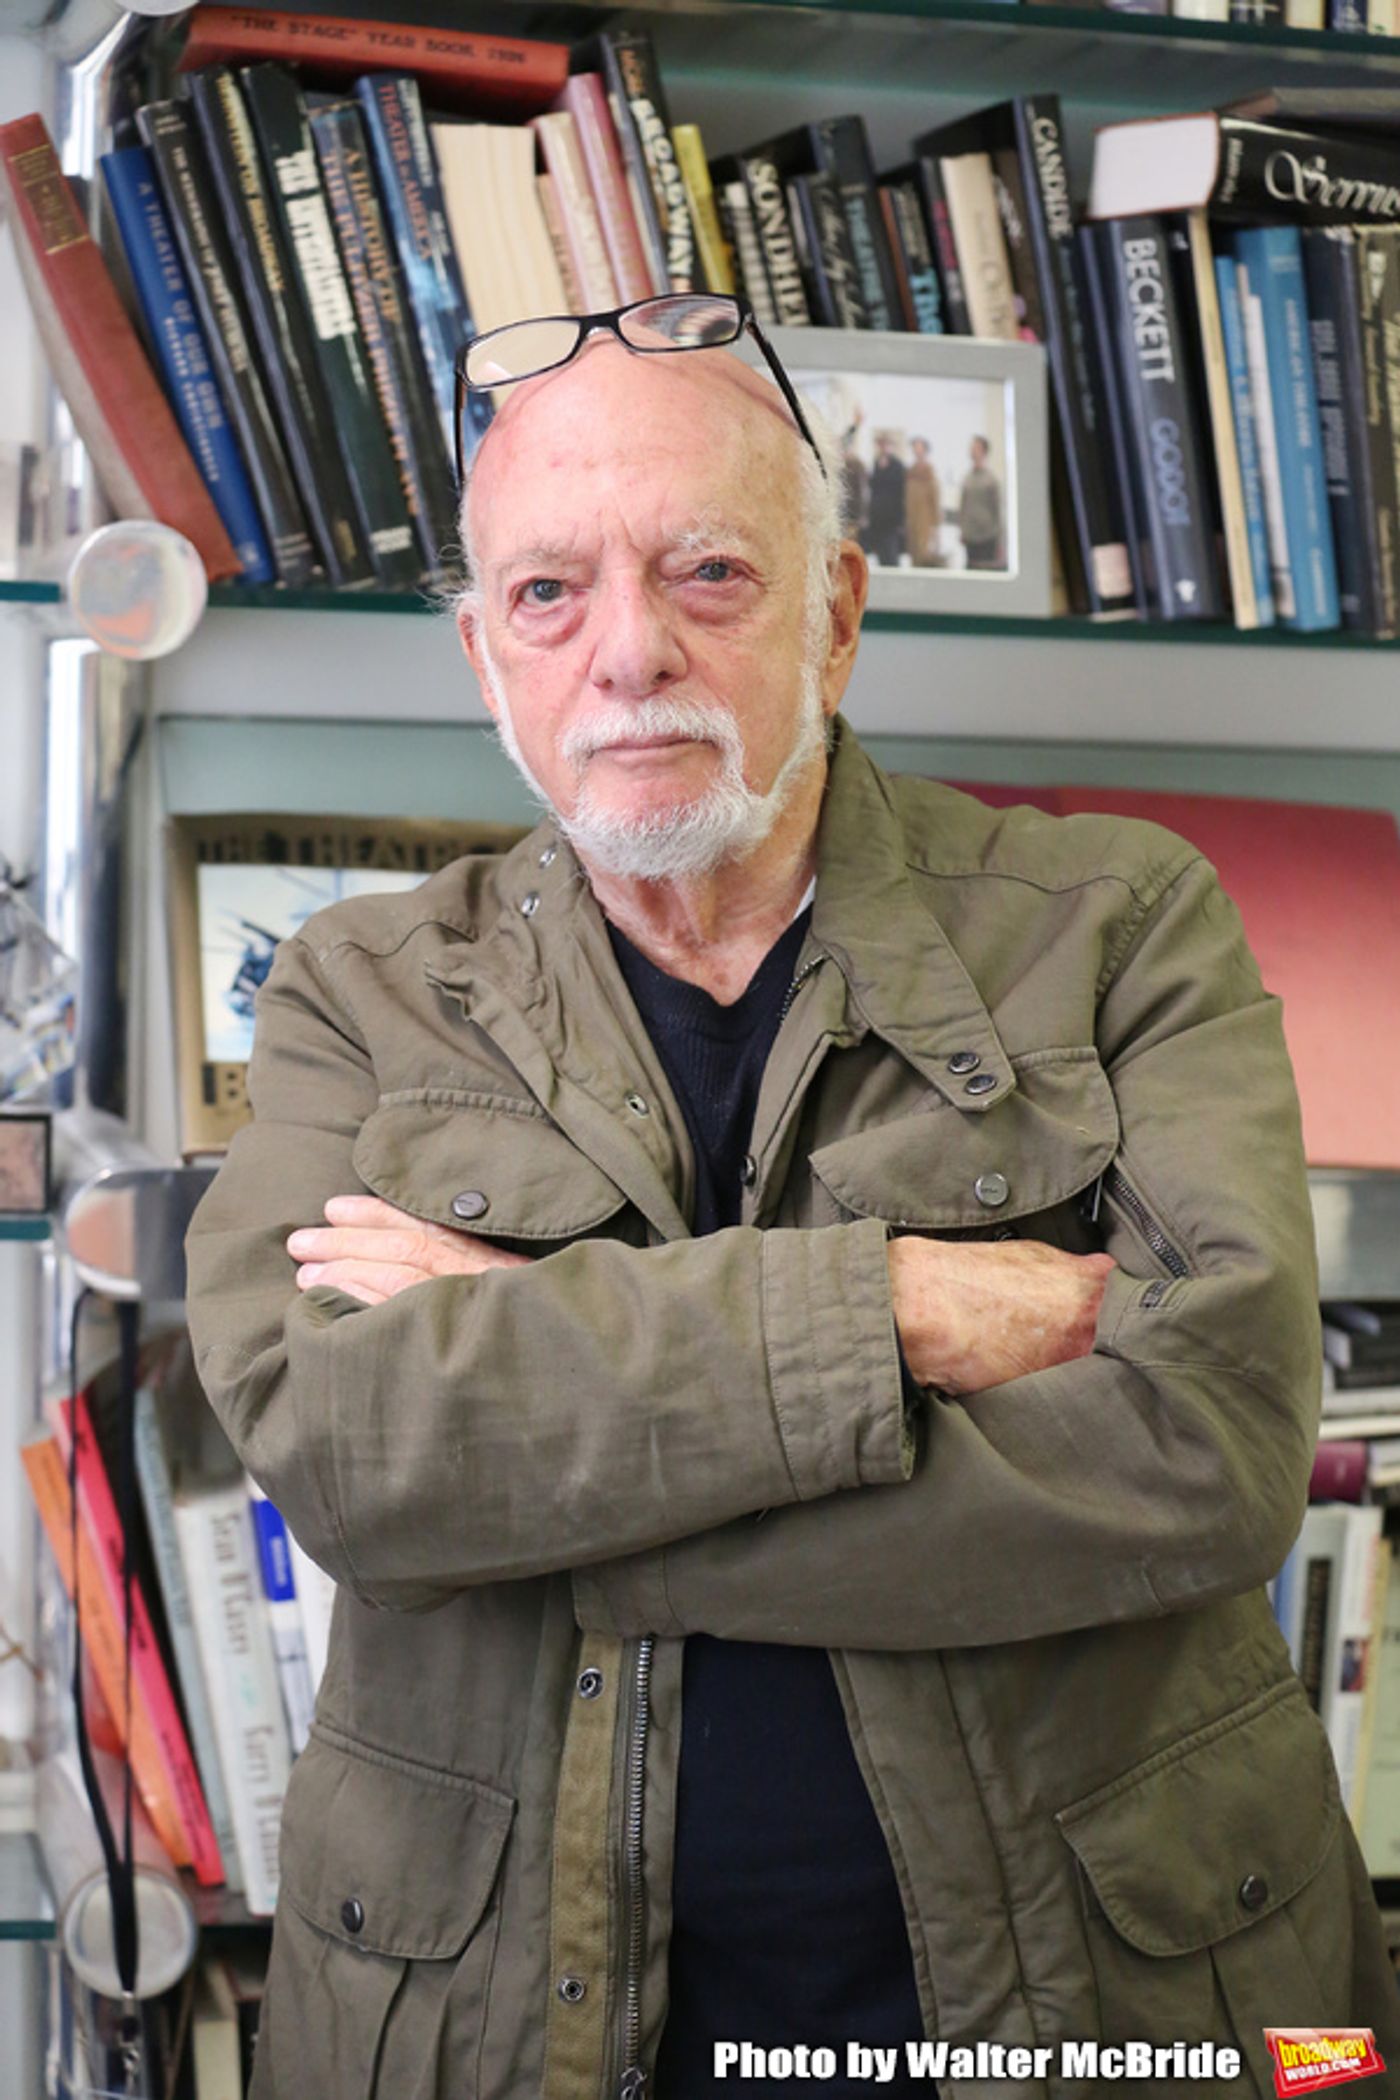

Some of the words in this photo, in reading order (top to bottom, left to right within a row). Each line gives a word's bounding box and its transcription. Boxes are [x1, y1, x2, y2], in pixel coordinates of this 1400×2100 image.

[367, 30, 415, 50] YEAR
[425, 38, 475, 59] BOOK
[321, 153, 351, 204] THE
[378, 81, 411, 162] THEATER
[402, 179, 434, 261] AMERICA
[630, 98, 693, 277] BROADWAY
[1031, 116, 1075, 241] CANDIDE
[144, 202, 184, 291] THEATER
[350, 169, 393, 280] HISTORY
[172, 299, 195, 324] OF
[334, 212, 382, 344] PULITZER
[1122, 236, 1176, 383] BECKETT
[183, 332, 209, 376] OUR
[366, 346, 405, 430] PRIZE
[197, 380, 224, 429] OWN
[1151, 416, 1192, 526] GODOT
